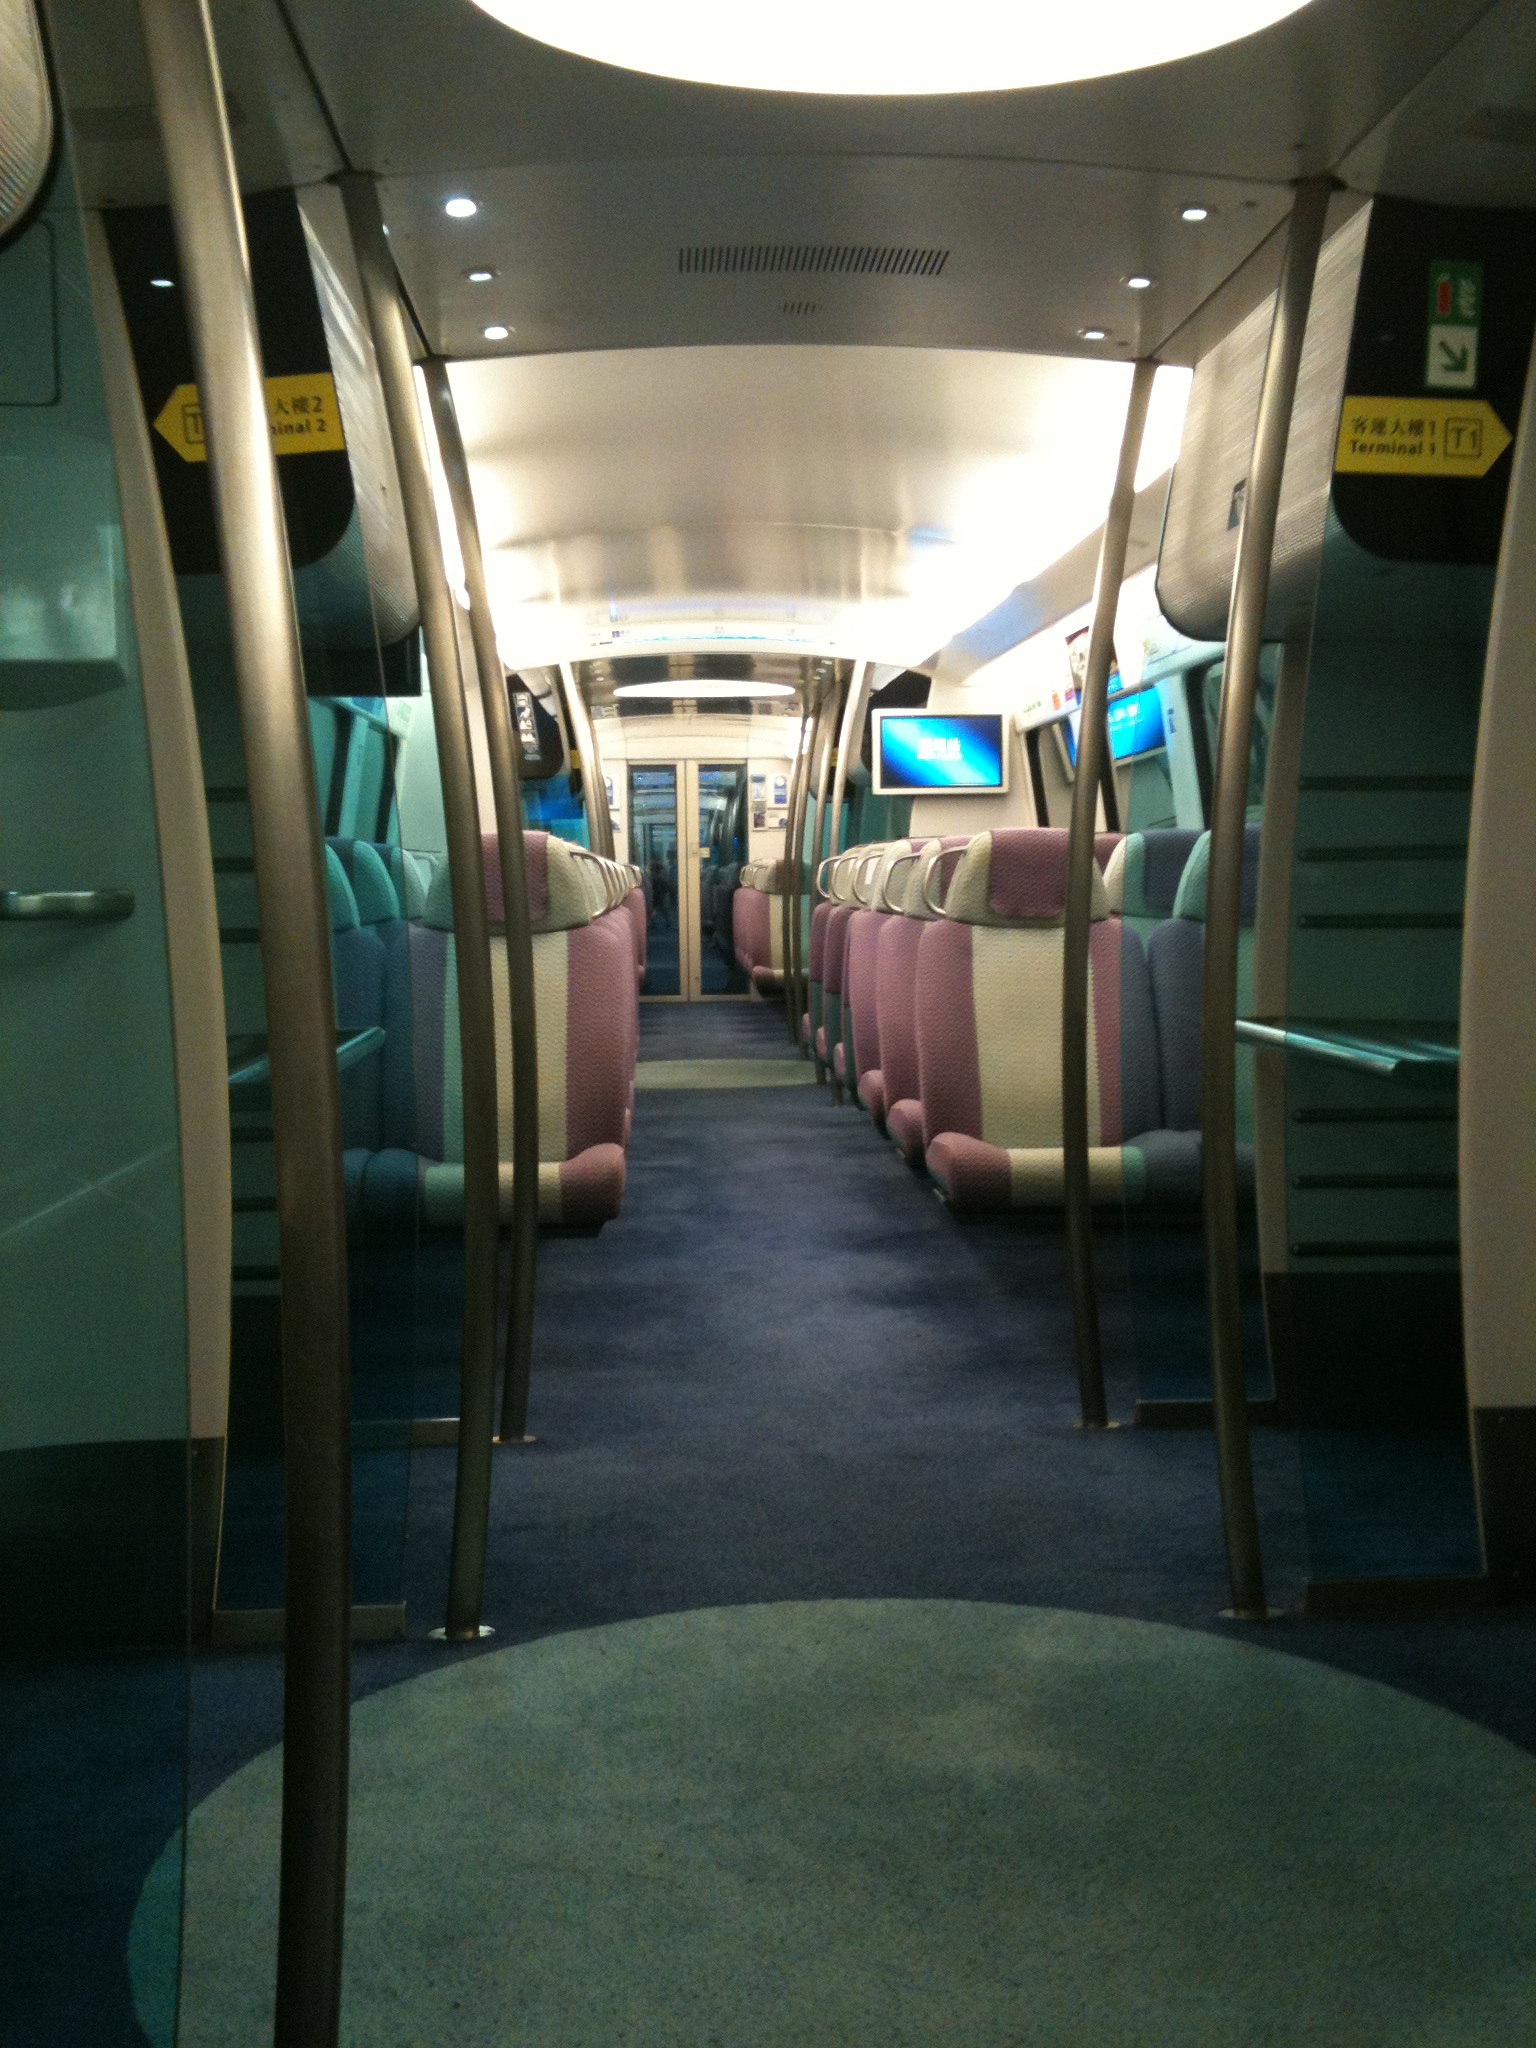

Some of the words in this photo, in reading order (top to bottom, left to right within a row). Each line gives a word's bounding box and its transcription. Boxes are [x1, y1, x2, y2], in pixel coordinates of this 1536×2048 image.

[273, 395, 323, 415] 大樓2
[187, 412, 203, 434] T
[316, 418, 327, 432] 2
[1350, 438, 1423, 456] Terminal
[1429, 441, 1437, 456] 1
[1450, 427, 1478, 449] T1
